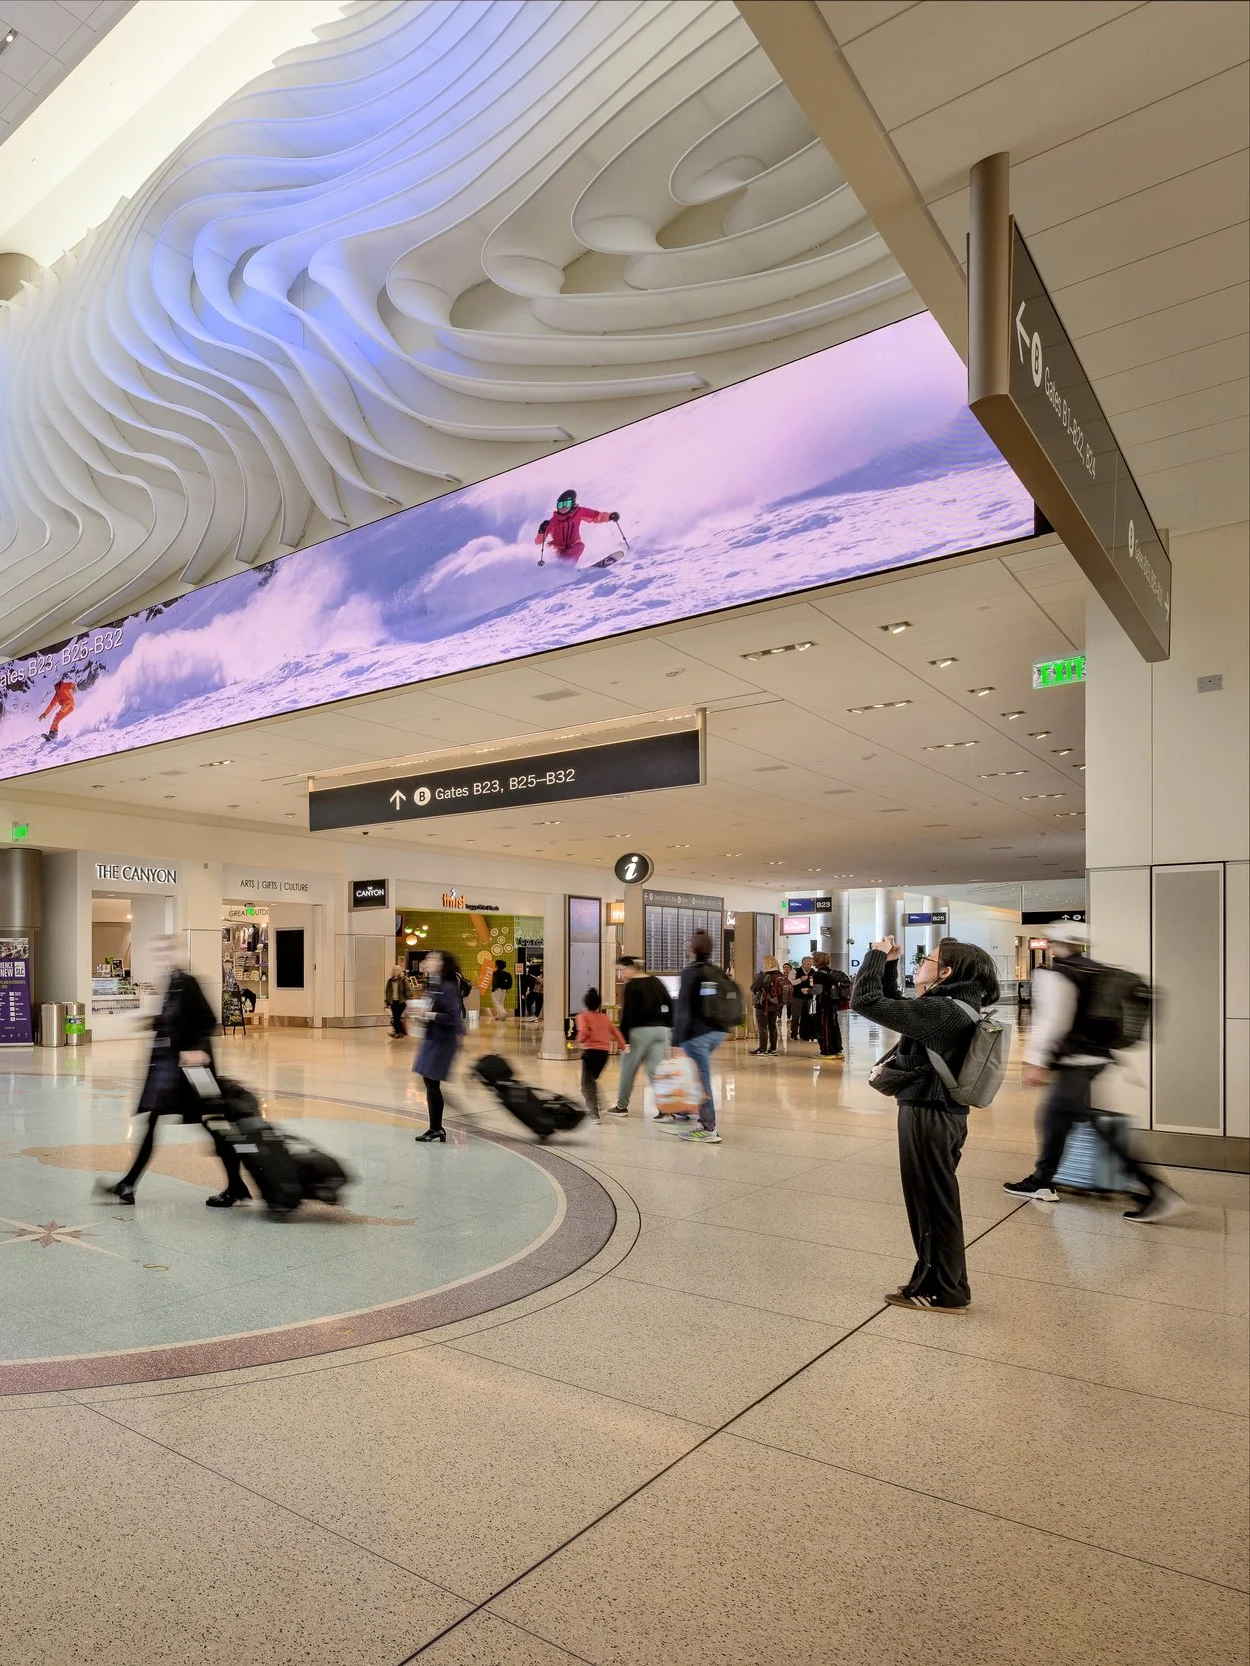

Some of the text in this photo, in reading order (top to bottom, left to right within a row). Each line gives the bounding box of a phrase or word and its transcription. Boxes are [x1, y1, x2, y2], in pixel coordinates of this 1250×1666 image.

[1044, 366, 1061, 418] Gates
[1085, 443, 1096, 480] B24
[28, 654, 58, 678] B23,
[61, 628, 123, 666] B25-B32
[1041, 657, 1086, 685] EXIT
[435, 787, 469, 800] Gates
[473, 780, 504, 795] B23,
[96, 864, 177, 884] THE CANYON
[240, 879, 309, 892] ARTS GIFTS CULTURE
[356, 889, 385, 897] CANYON
[0, 968, 14, 977] NEW
[15, 968, 25, 976] SLC
